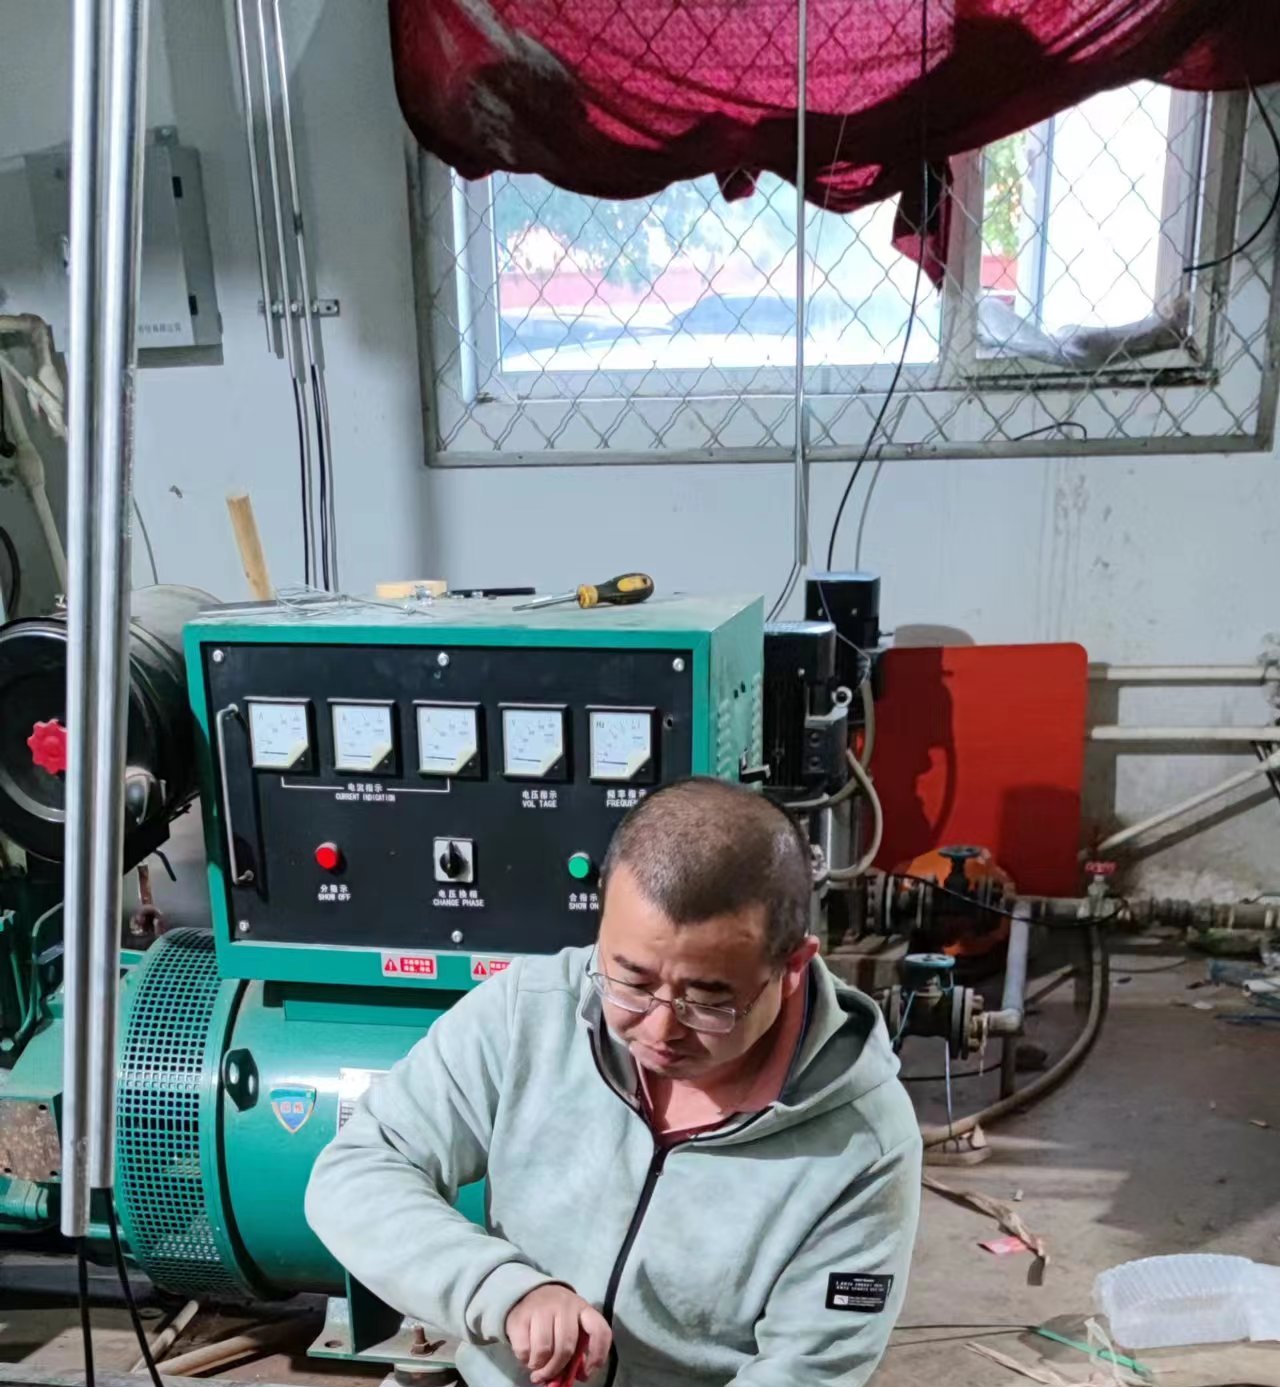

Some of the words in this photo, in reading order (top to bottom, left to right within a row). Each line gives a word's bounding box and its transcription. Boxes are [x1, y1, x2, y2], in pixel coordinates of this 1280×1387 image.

[522, 790, 558, 800] 电压指示
[432, 898, 460, 907] CHANGE
[462, 899, 485, 907] PHASE
